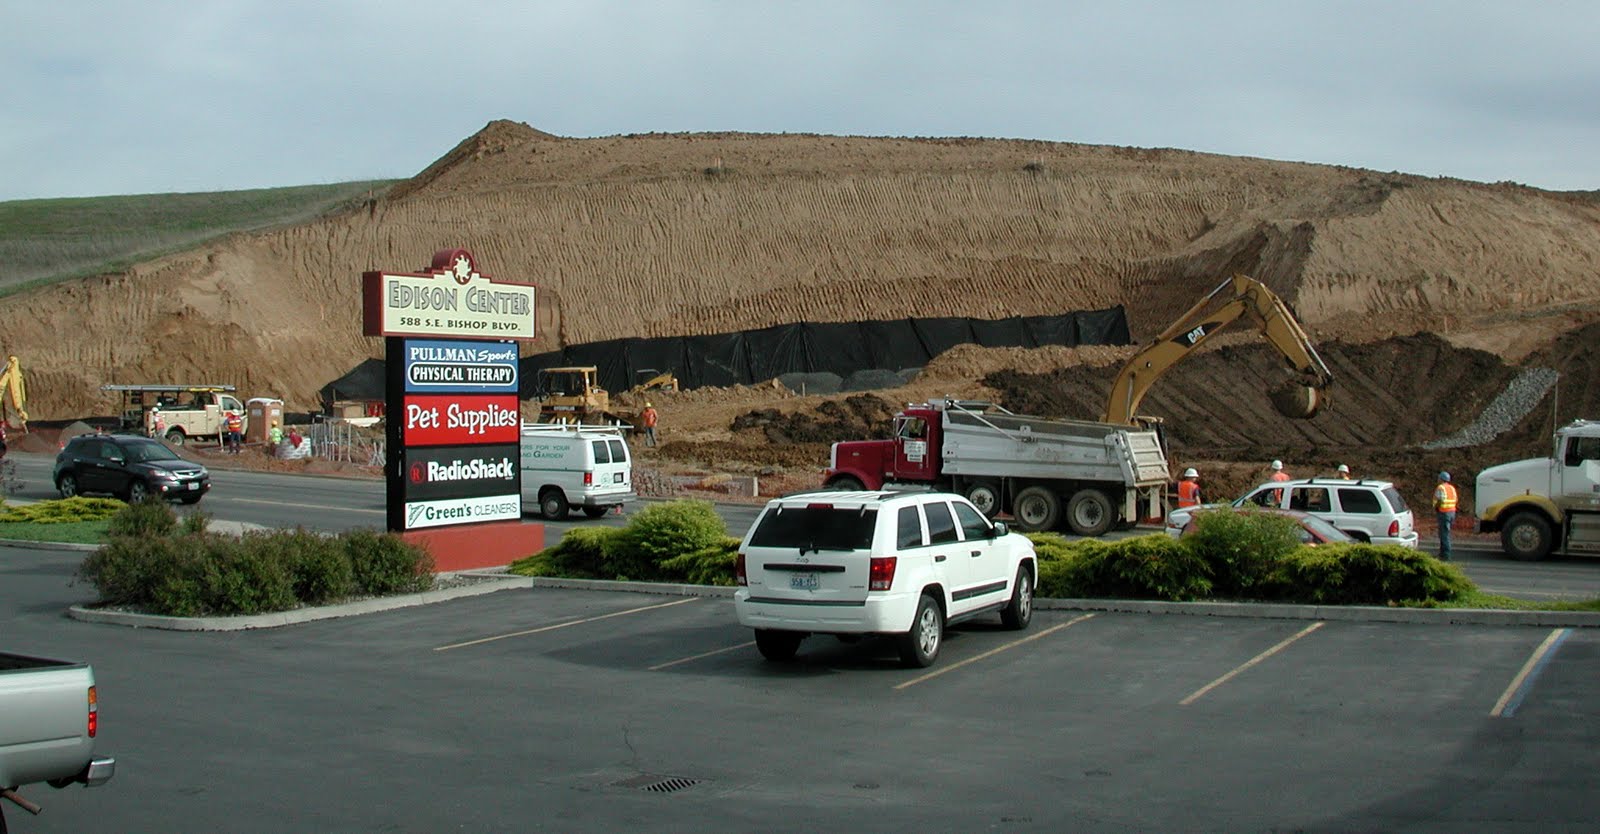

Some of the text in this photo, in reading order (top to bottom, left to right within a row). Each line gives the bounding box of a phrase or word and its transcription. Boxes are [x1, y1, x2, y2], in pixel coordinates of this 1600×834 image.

[388, 280, 531, 317] EDISON CENTER
[400, 316, 521, 331] 588 S.E. BISHOP BLVD.
[1187, 325, 1206, 344] CAT
[410, 347, 516, 363] PULLMAN Sports
[413, 366, 512, 382] PHYSICAL THERAPY
[407, 403, 518, 435] Pet Supplies
[427, 457, 514, 482] RadioShack
[425, 502, 518, 521] Green's CLEANERS
